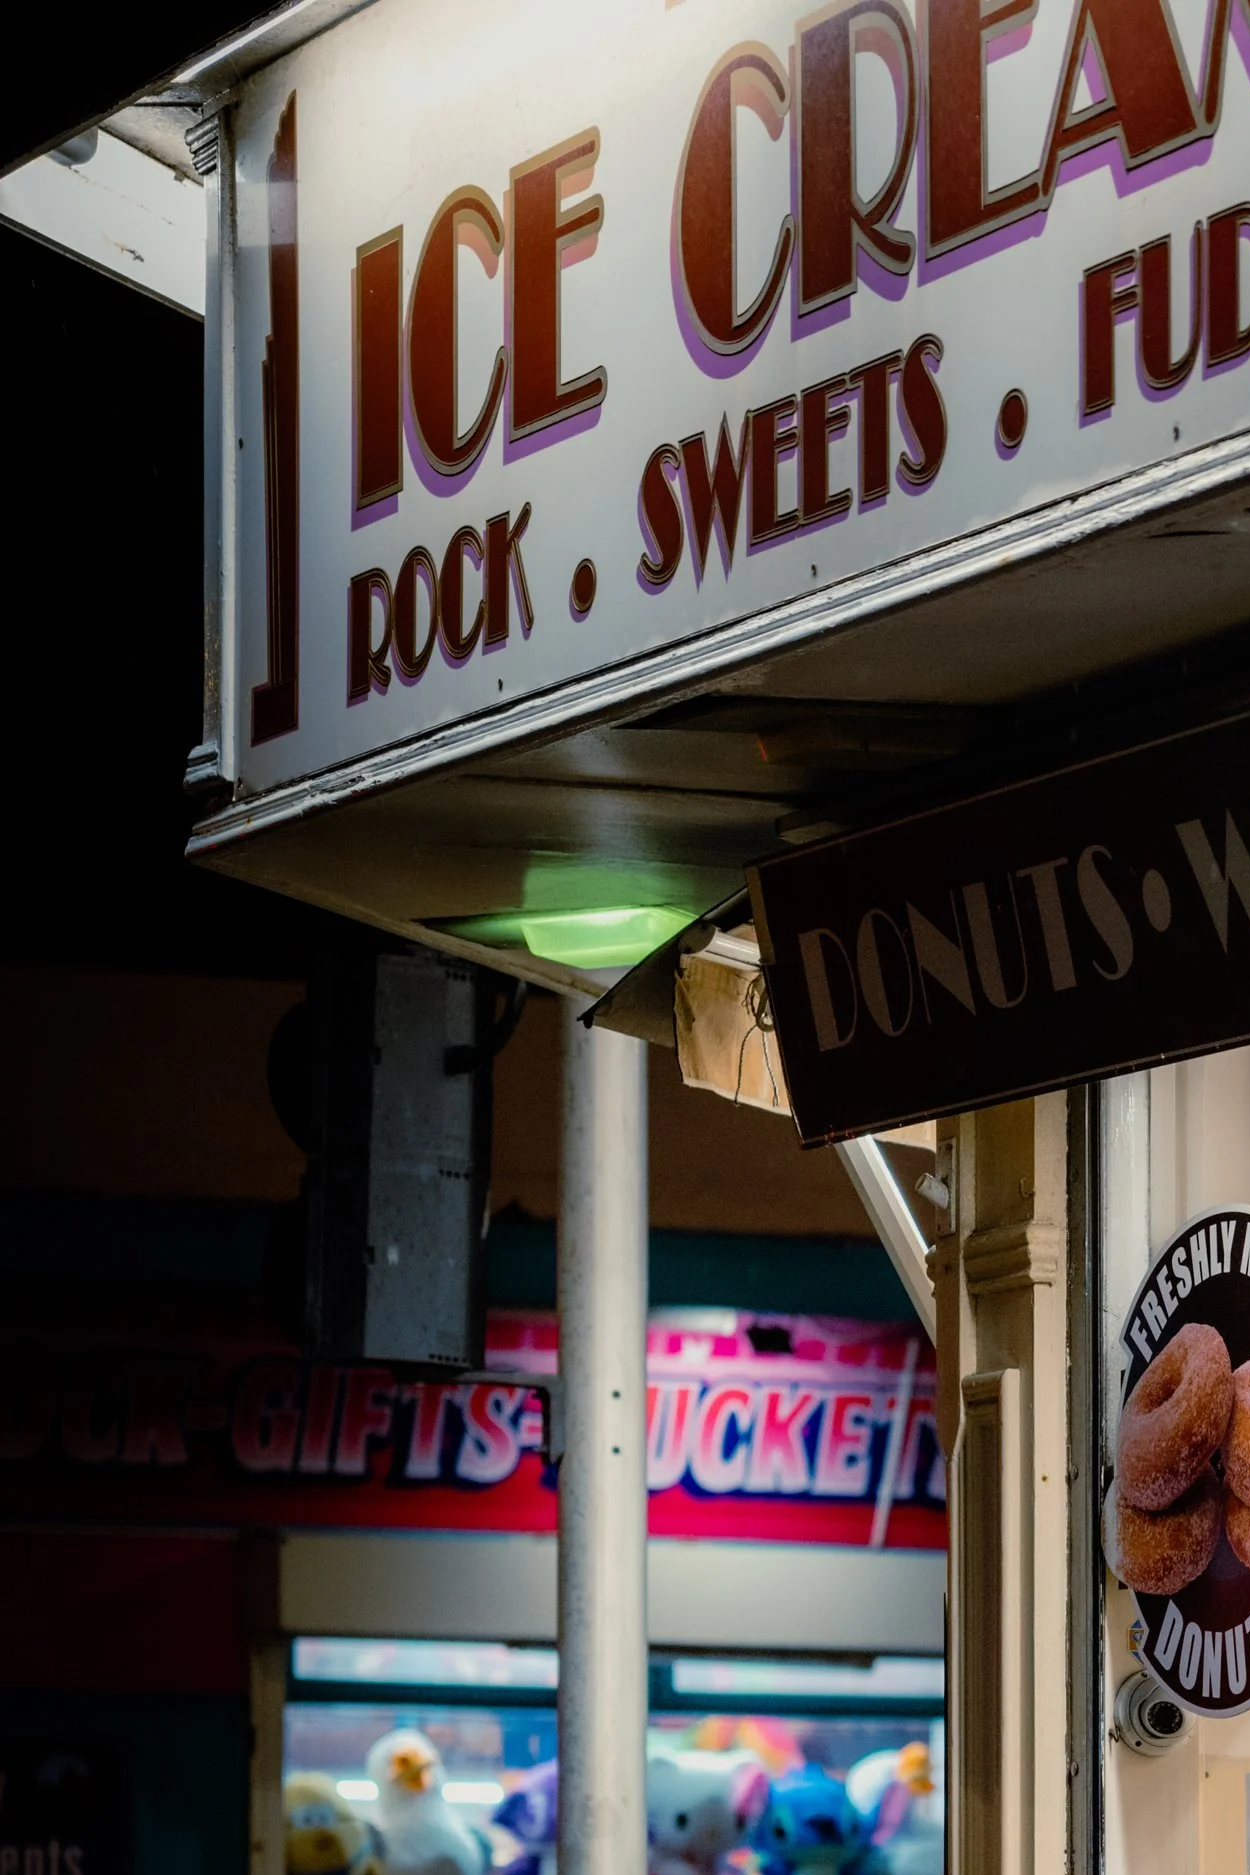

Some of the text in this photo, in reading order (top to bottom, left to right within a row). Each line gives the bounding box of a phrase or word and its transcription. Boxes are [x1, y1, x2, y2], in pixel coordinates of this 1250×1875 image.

[351, 126, 608, 531] ICE
[348, 502, 535, 701] ROCK
[638, 333, 948, 585] SWEETS
[798, 844, 1135, 1052] DONUTS
[1131, 1219, 1237, 1361] FRESHLY
